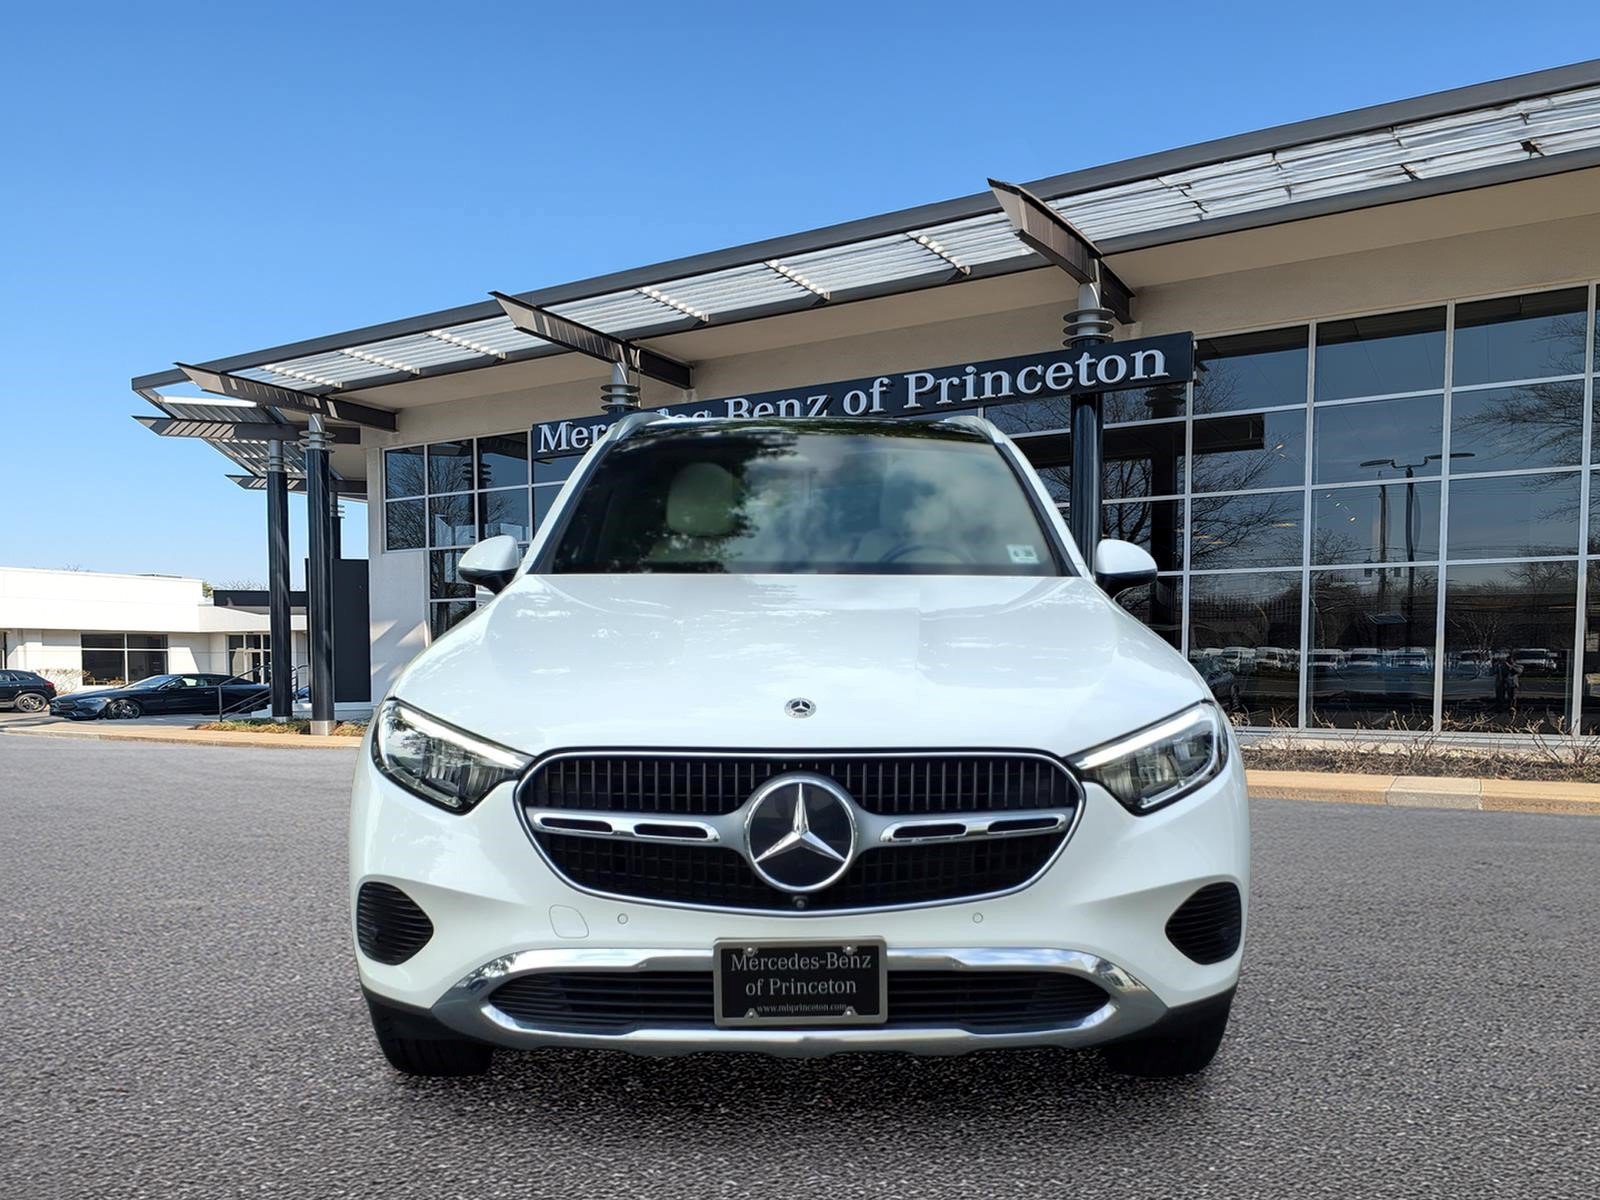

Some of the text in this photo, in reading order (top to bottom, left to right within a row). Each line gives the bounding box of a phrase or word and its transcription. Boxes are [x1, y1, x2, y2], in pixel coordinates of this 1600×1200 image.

[843, 376, 892, 416] of
[903, 348, 1169, 409] Princeton
[731, 952, 872, 972] Mercedes-Benz
[745, 978, 856, 996] of Princeton
[757, 1003, 847, 1013] www.mbprinceton.com
